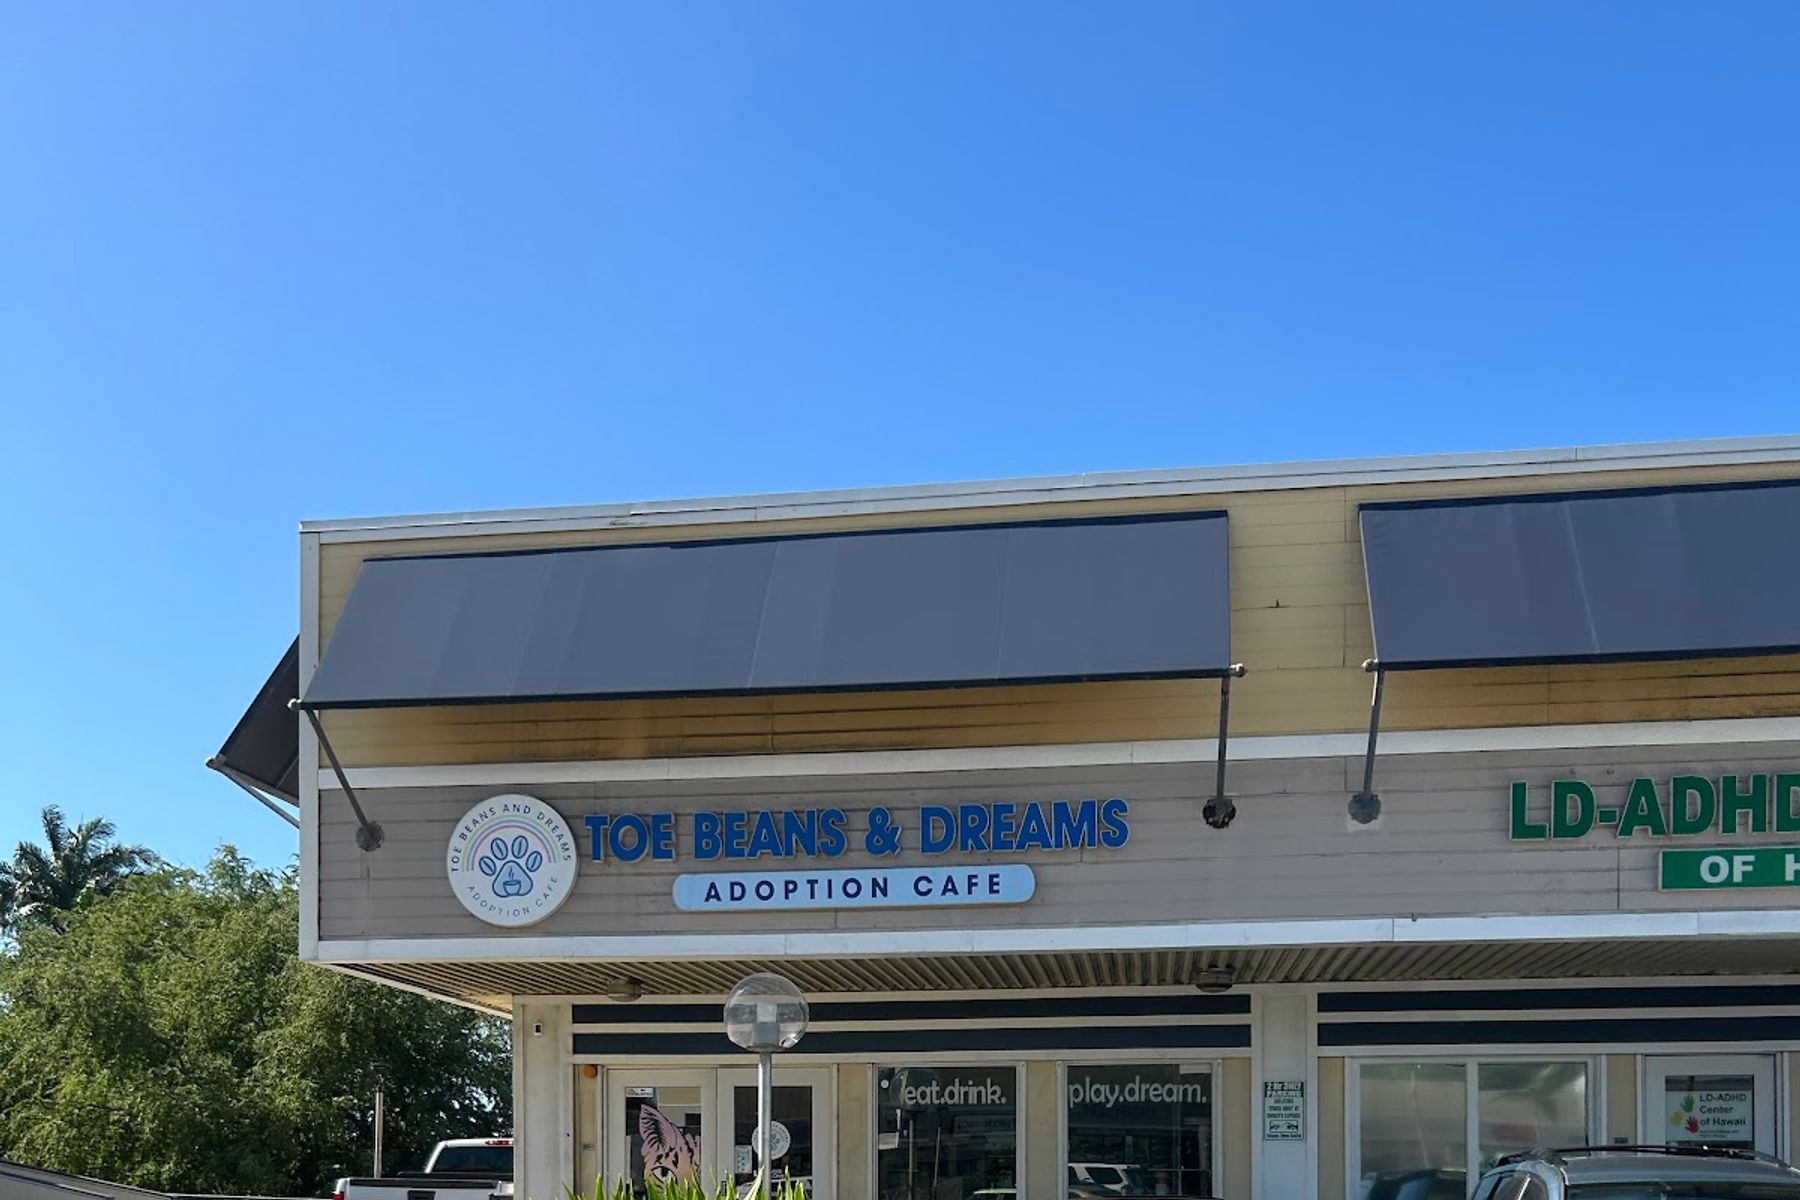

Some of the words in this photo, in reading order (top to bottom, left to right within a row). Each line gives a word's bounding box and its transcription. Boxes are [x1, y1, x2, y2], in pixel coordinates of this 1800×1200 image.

[451, 846, 462, 872] TOE
[459, 807, 496, 841] BEANS
[502, 804, 531, 814] AND
[537, 811, 571, 861] DREAMS
[585, 812, 677, 863] TOE
[693, 808, 848, 860] BEANS
[864, 805, 901, 857] &
[919, 799, 1130, 854] DREAMS
[1699, 855, 1755, 884] OF
[468, 885, 530, 917] ADOPTION
[535, 876, 558, 907] CAFE
[704, 878, 888, 902] ADOPTION
[913, 873, 1000, 897] CAFE
[1068, 1075, 1207, 1108] play.dream.
[1700, 1093, 1747, 1102] LD-ADHD
[1700, 1105, 1734, 1114] Center
[1700, 1117, 1710, 1126] of
[1712, 1117, 1747, 1126] Hawaii
